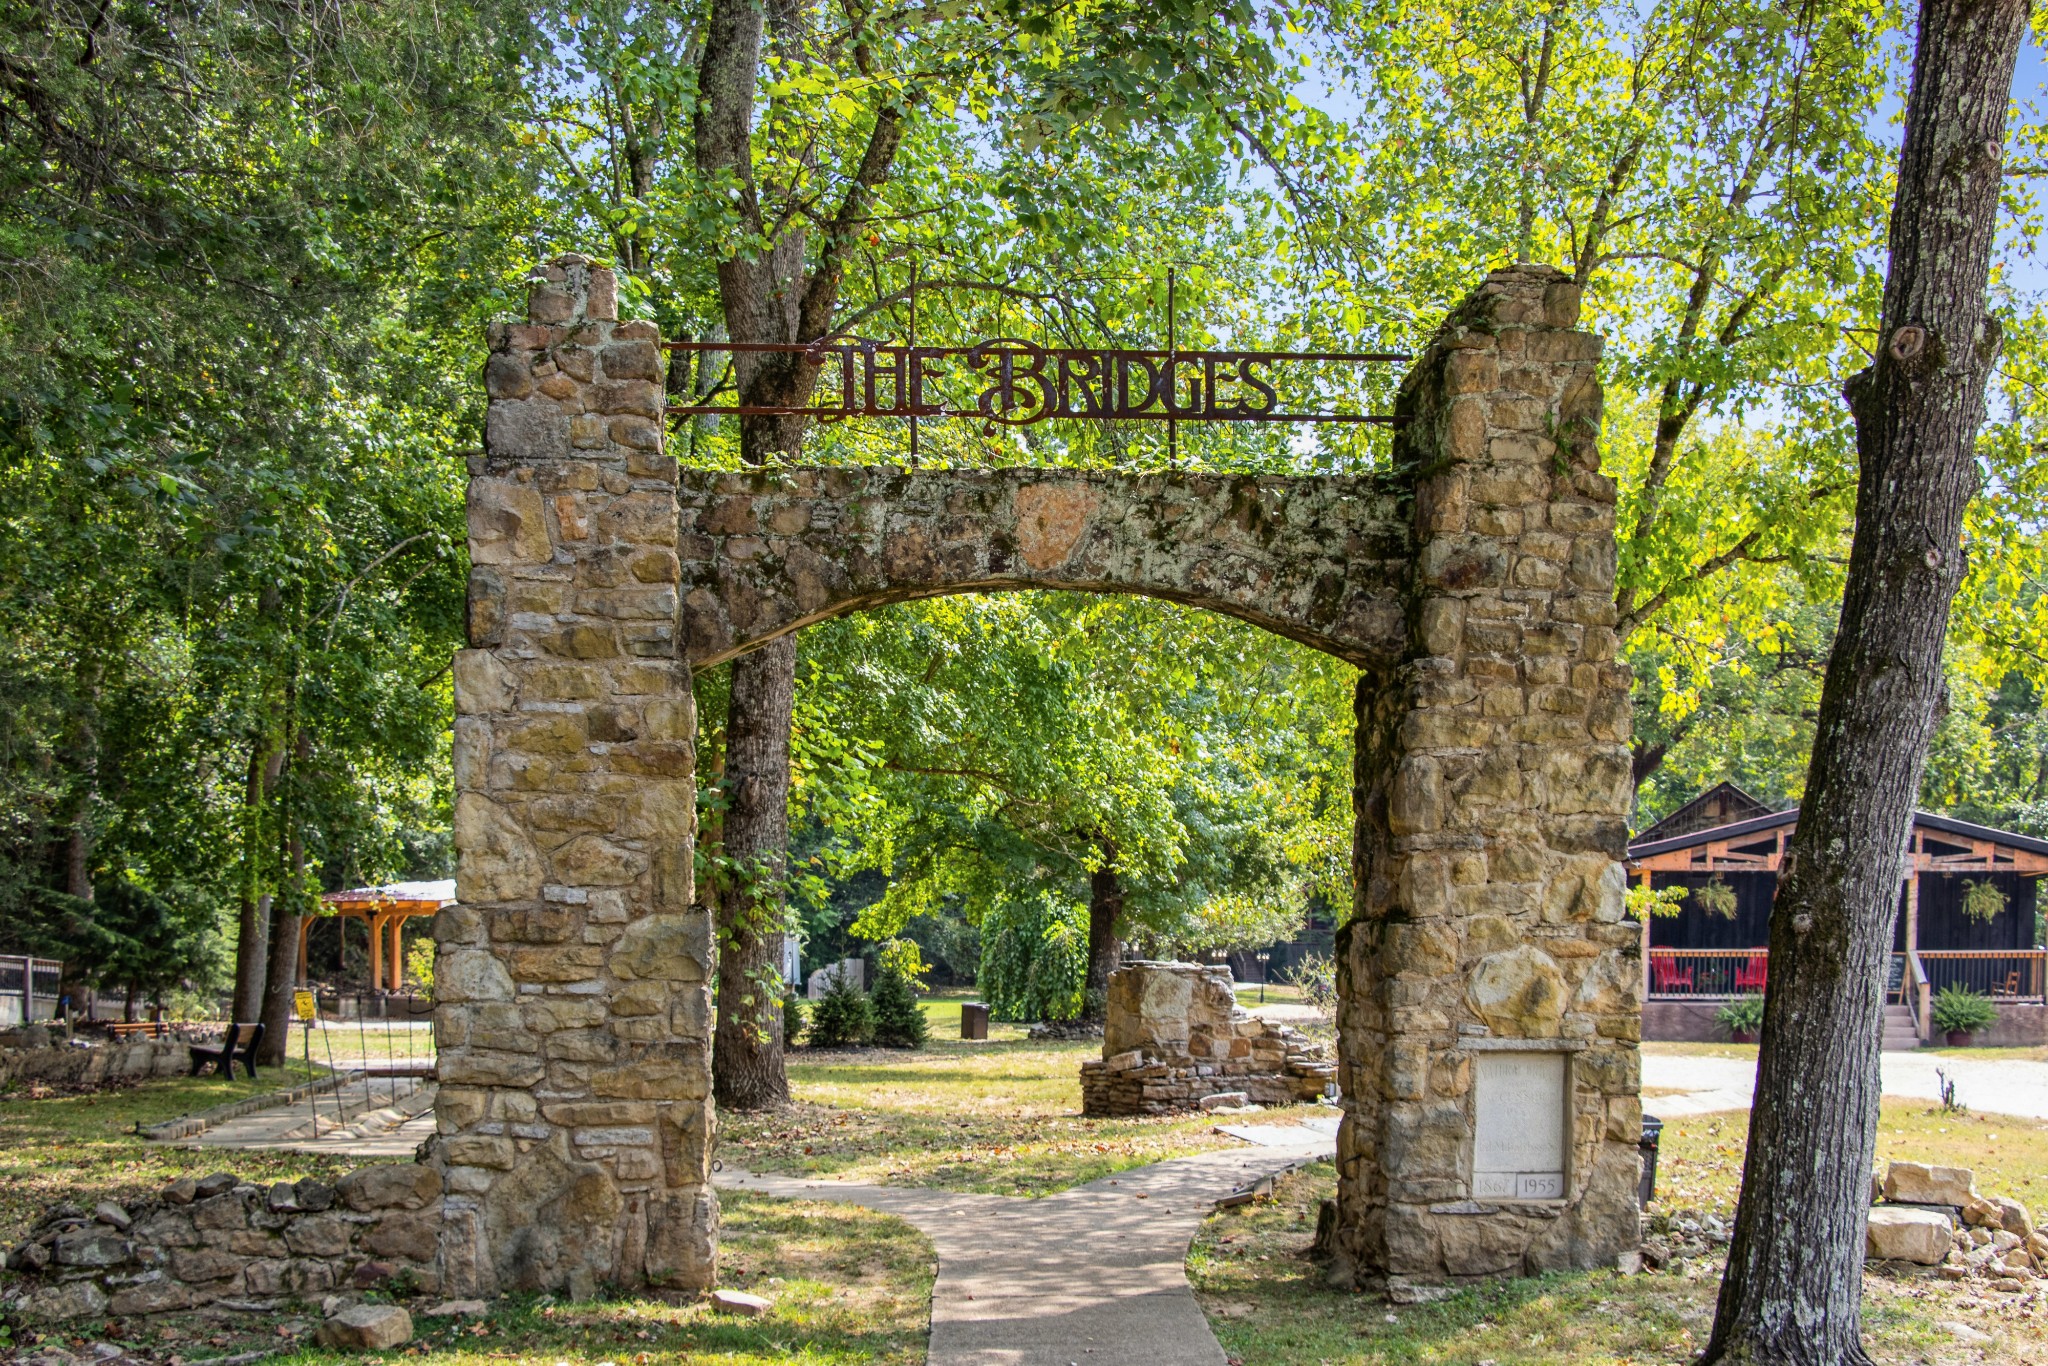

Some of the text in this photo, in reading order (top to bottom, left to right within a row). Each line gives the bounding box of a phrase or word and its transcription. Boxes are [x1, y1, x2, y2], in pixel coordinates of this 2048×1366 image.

[806, 332, 1277, 437] THE BRIDGES
[1480, 1179, 1555, 1193] 1867 1955
